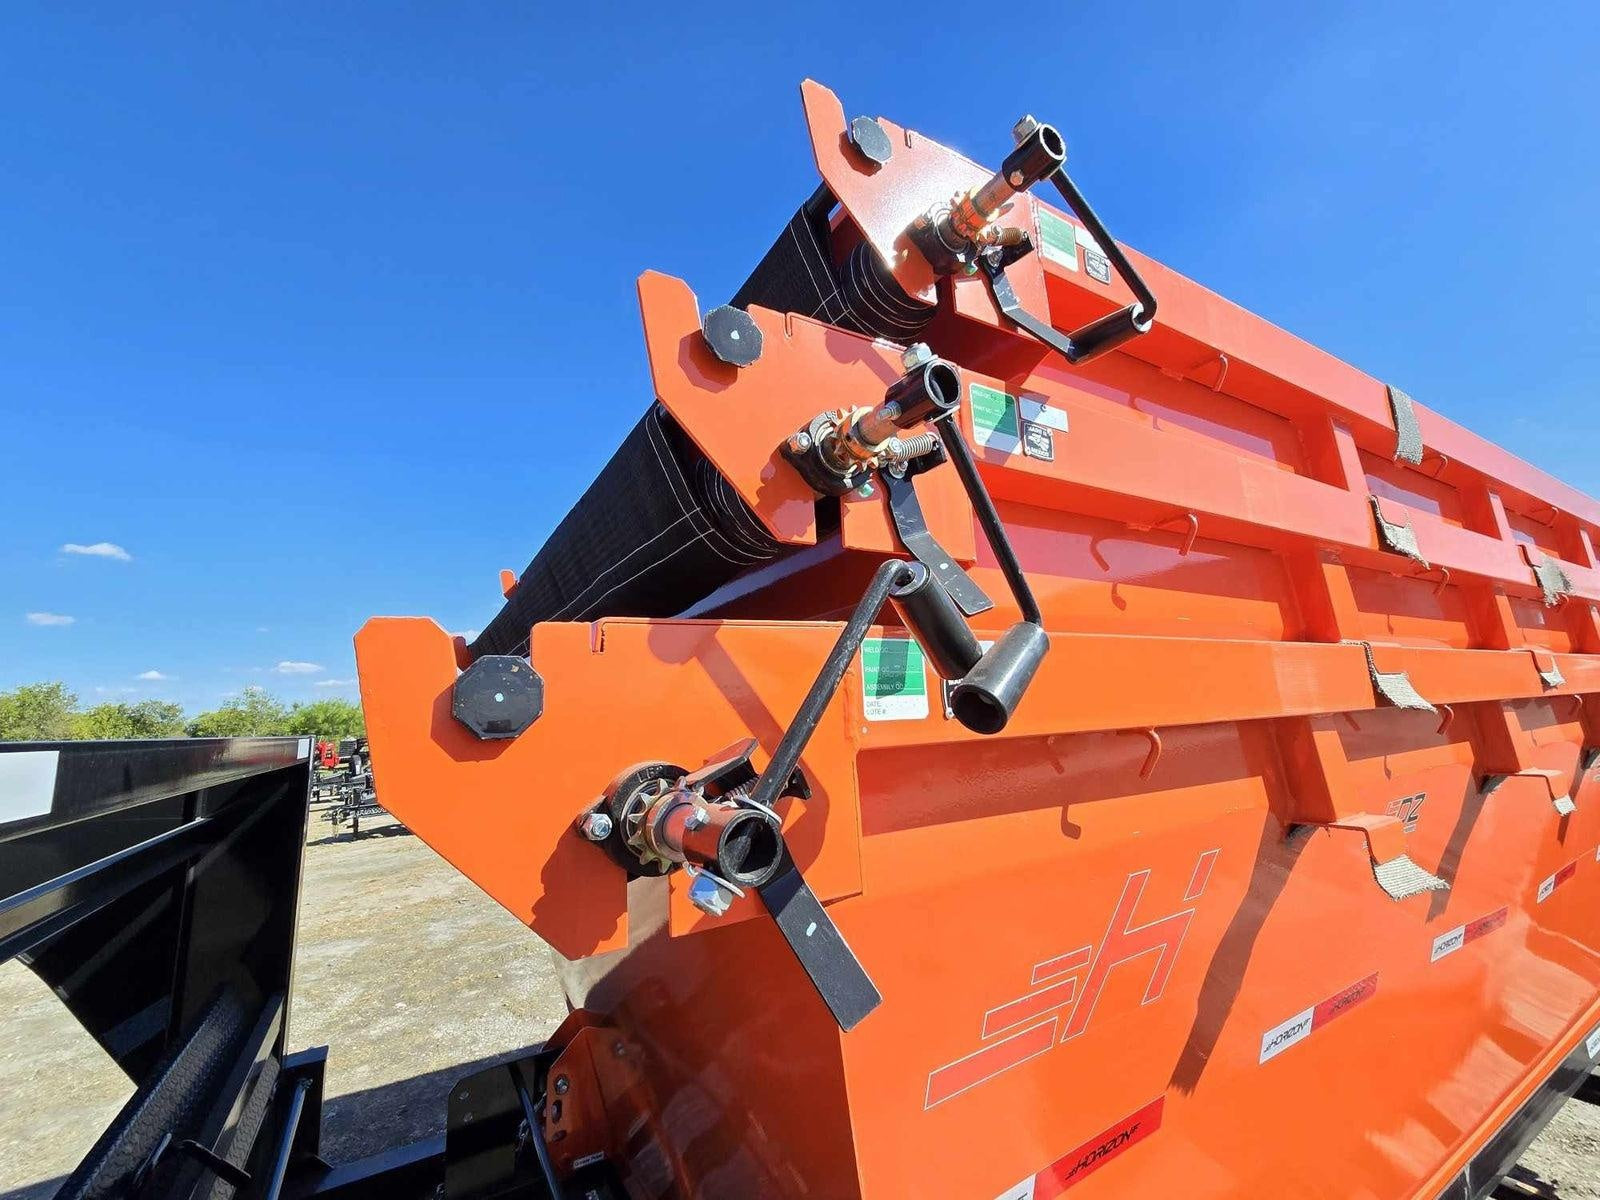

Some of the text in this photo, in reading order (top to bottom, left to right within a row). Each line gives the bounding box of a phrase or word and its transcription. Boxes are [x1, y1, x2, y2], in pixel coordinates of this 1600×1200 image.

[866, 683, 894, 691] ASSEMBLY
[1266, 1019, 1309, 1051] HORIZON
[1068, 1125, 1137, 1179] HORIZON
